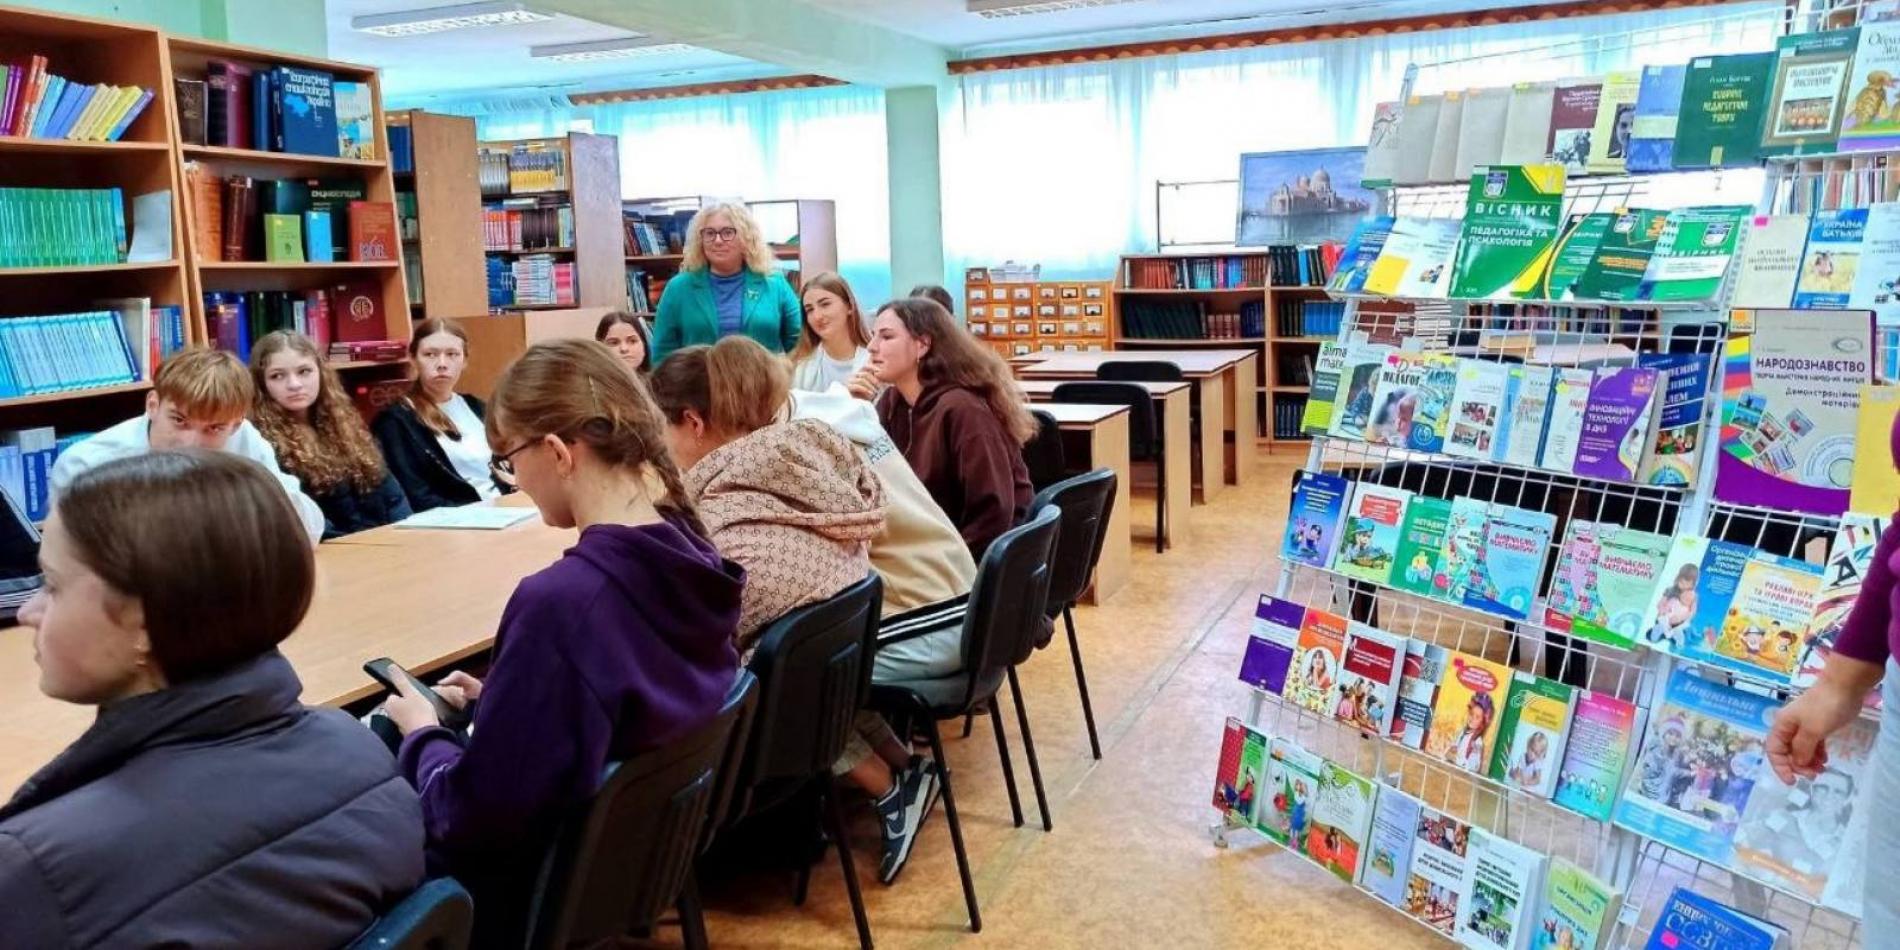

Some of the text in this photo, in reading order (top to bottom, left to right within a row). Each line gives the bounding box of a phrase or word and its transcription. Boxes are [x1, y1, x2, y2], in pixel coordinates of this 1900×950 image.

[1475, 202, 1552, 217] ВІСНИК
[1470, 226, 1548, 238] ПЕДАГОГІКА ТА
[1468, 235, 1533, 247] ПСИХОЛОГІЯ
[1756, 357, 1866, 373] НАРОДОЗНАВСТВО
